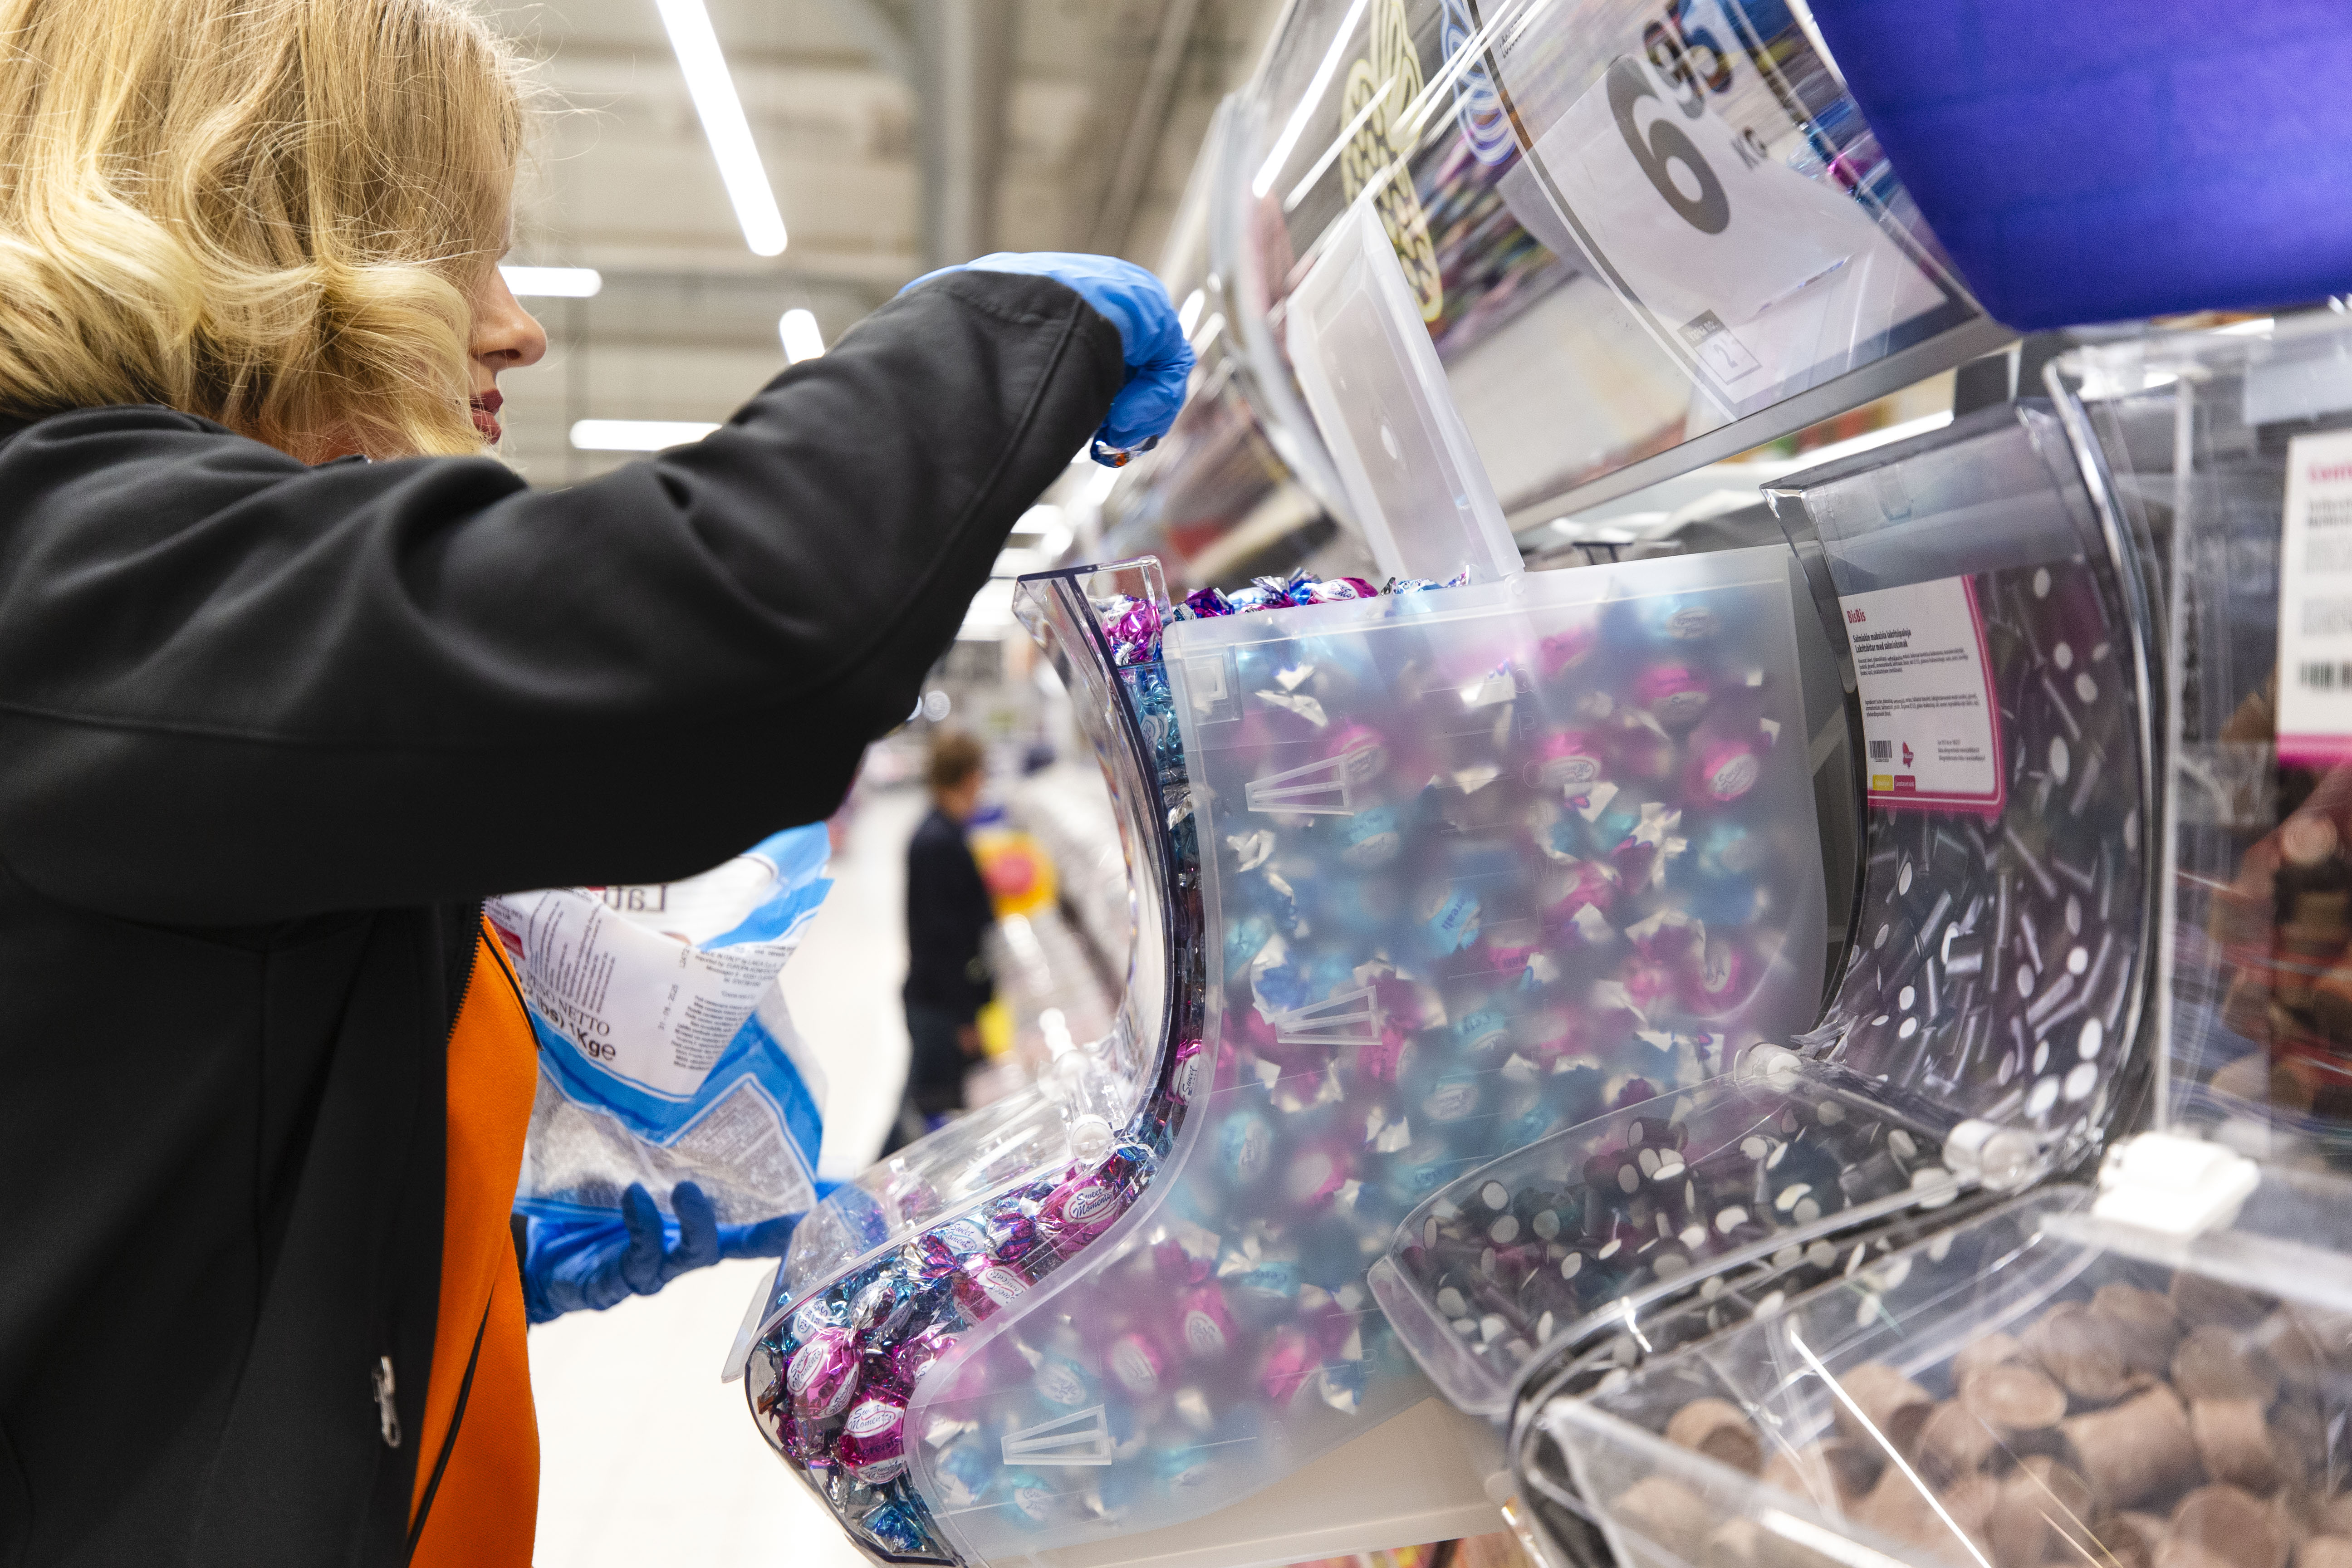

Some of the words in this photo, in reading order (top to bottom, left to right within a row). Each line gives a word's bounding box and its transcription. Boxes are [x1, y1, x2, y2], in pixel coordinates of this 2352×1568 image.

[1607, 54, 1730, 235] 6
[1847, 608, 1866, 624] BisBis
[1876, 642, 1885, 652] med
[559, 998, 610, 1036] NETTO
[1182, 1065, 1197, 1093] Sweet
[1072, 1193, 1112, 1218] Moments
[1077, 1188, 1102, 1206] Sweet
[950, 1223, 975, 1237] Sweet
[790, 1346, 809, 1377] Sweet
[792, 1350, 822, 1390] Moments
[849, 1411, 892, 1430] Moments
[854, 1403, 880, 1420] Sweet
